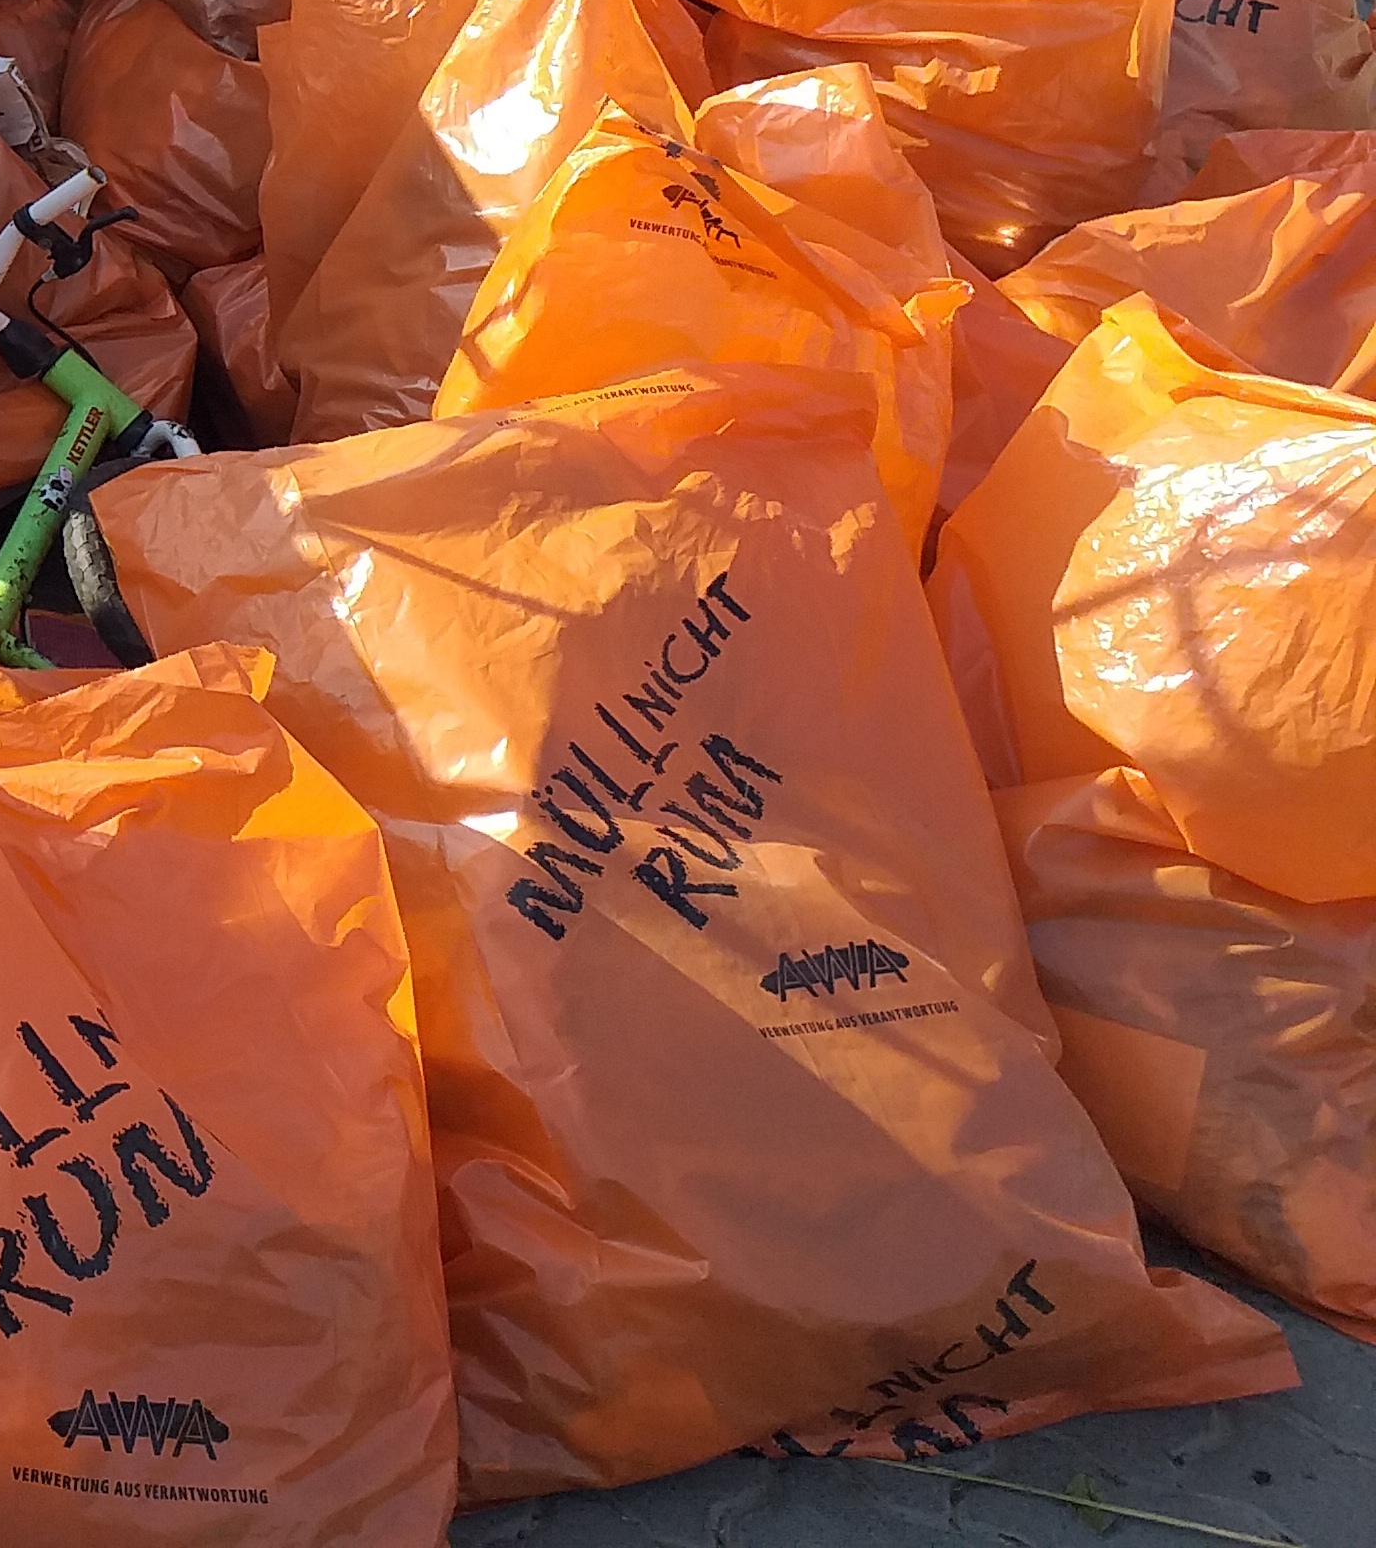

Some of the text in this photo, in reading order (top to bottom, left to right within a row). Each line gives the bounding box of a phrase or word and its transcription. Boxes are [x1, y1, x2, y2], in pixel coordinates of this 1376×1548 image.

[66, 406, 105, 467] KETTLER
[505, 702, 680, 942] MÜLL
[631, 733, 784, 931] RUM
[768, 938, 909, 1002] AWA
[758, 1000, 960, 1039] VERWERTUNG AUS VERANTWORTUNG
[56, 1389, 224, 1461] AWA
[11, 1466, 269, 1506] VERWERTUNG AUS VERANTWORTUNG
